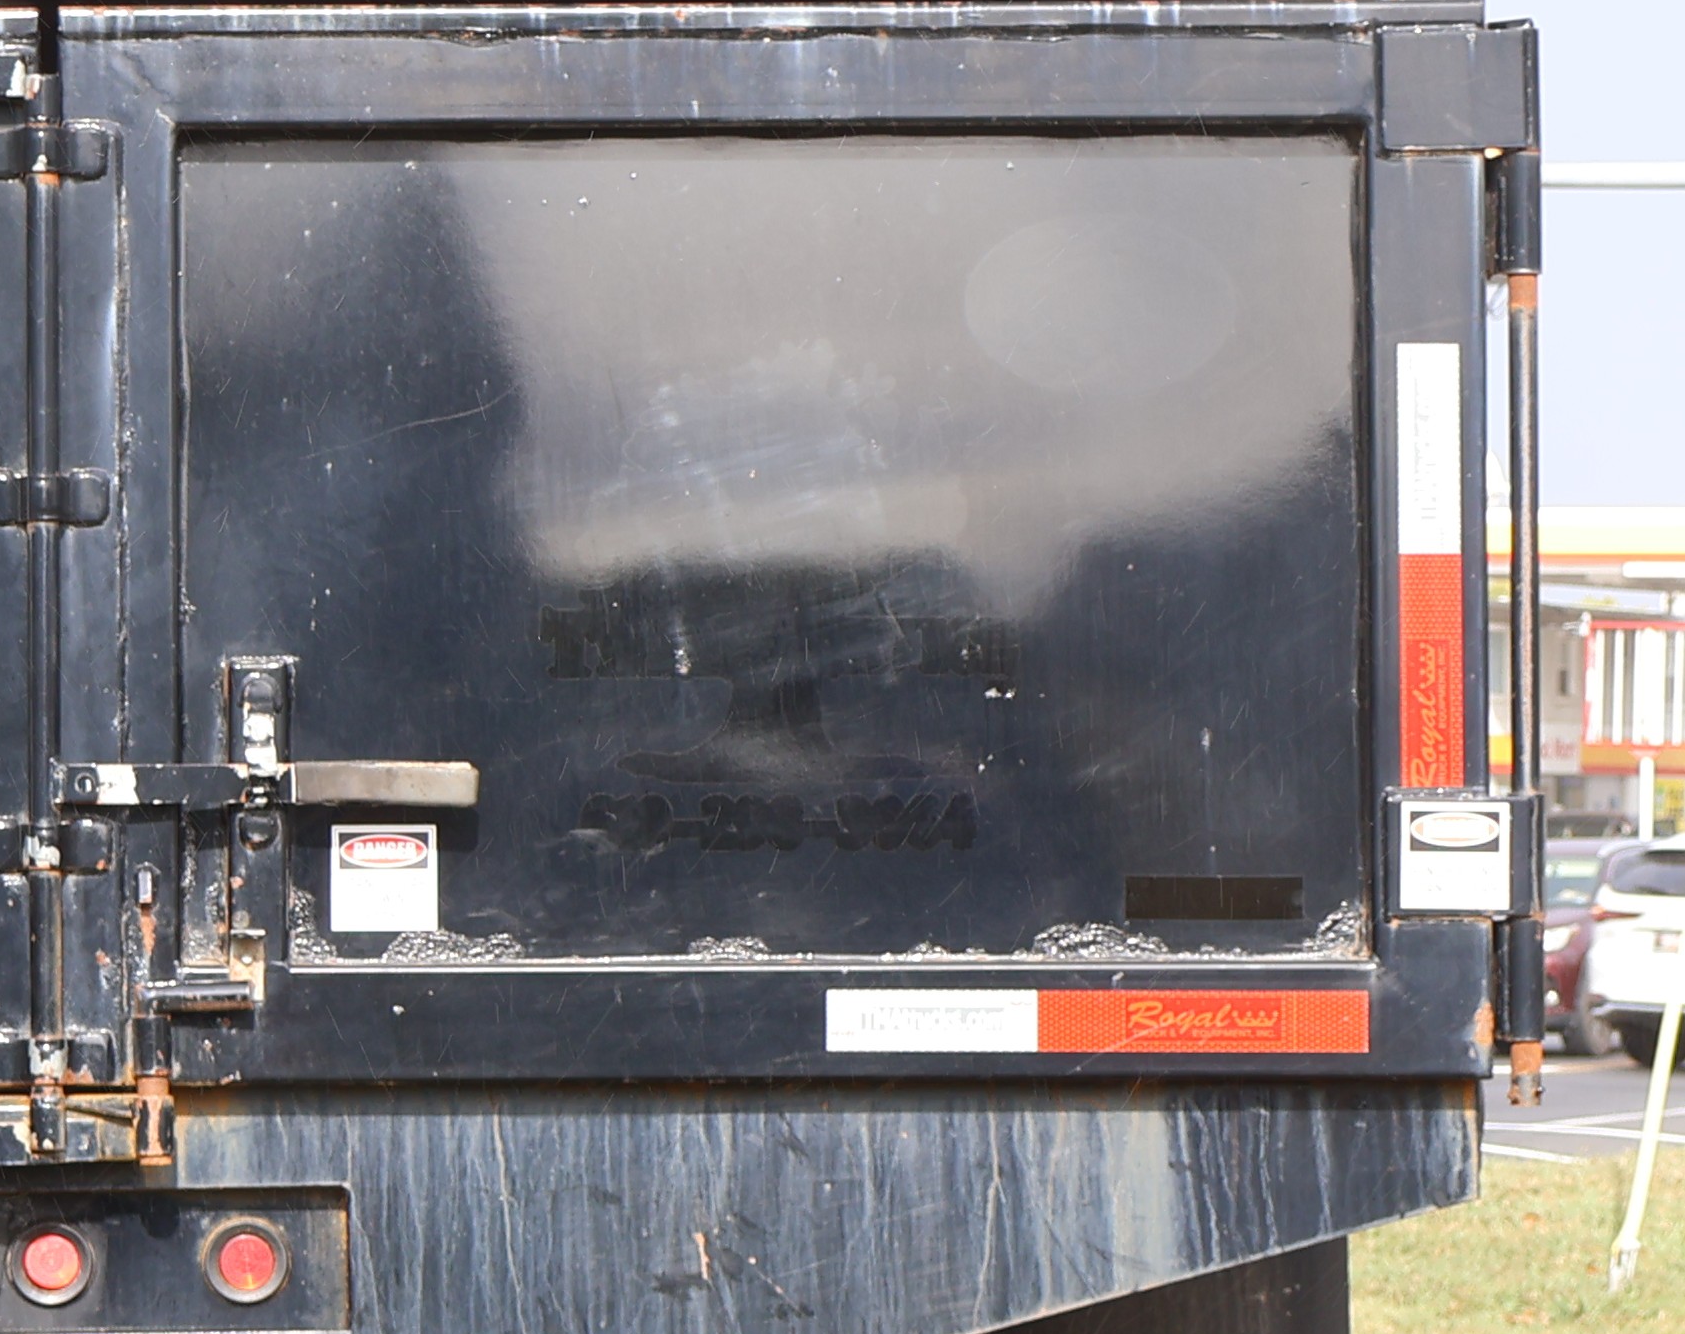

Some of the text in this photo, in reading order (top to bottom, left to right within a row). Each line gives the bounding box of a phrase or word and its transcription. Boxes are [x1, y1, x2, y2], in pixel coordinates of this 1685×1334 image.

[1410, 689, 1444, 787] Royal
[352, 840, 418, 860] DANGER
[1127, 1000, 1232, 1035] Royal
